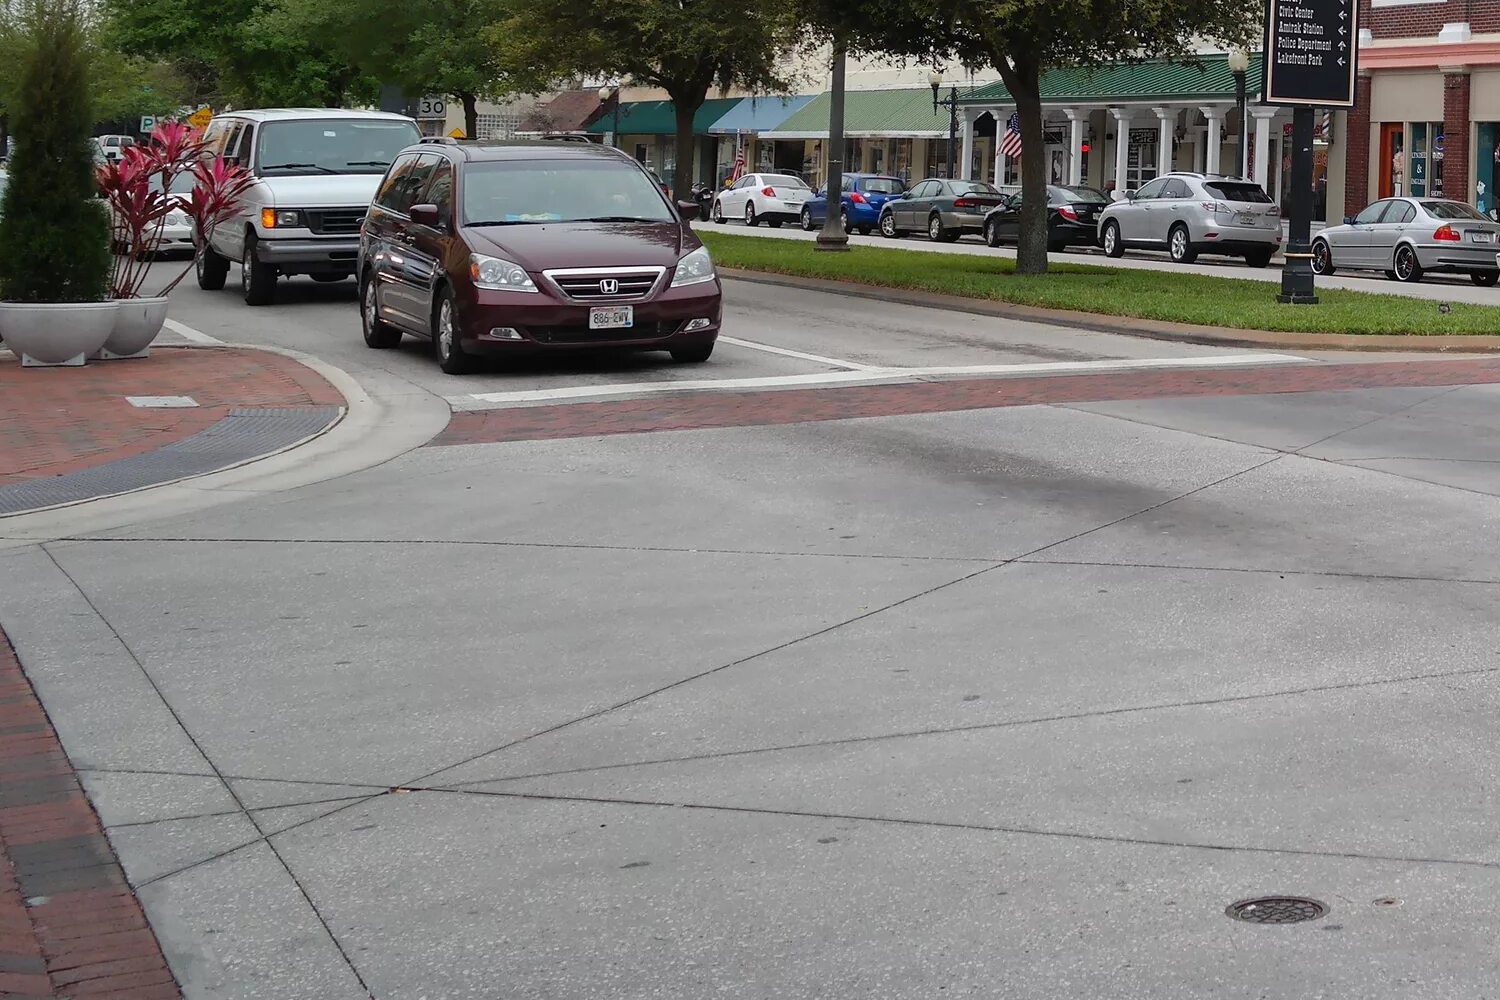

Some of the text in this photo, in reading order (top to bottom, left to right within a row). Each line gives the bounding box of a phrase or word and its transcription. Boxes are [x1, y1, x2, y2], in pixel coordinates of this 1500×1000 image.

[1279, 5, 1314, 19] Civic Center
[1278, 21, 1324, 35] Amtrak Station
[1278, 36, 1332, 51] Police Department
[1277, 52, 1323, 66] Lakefront Park
[421, 101, 444, 114] 30
